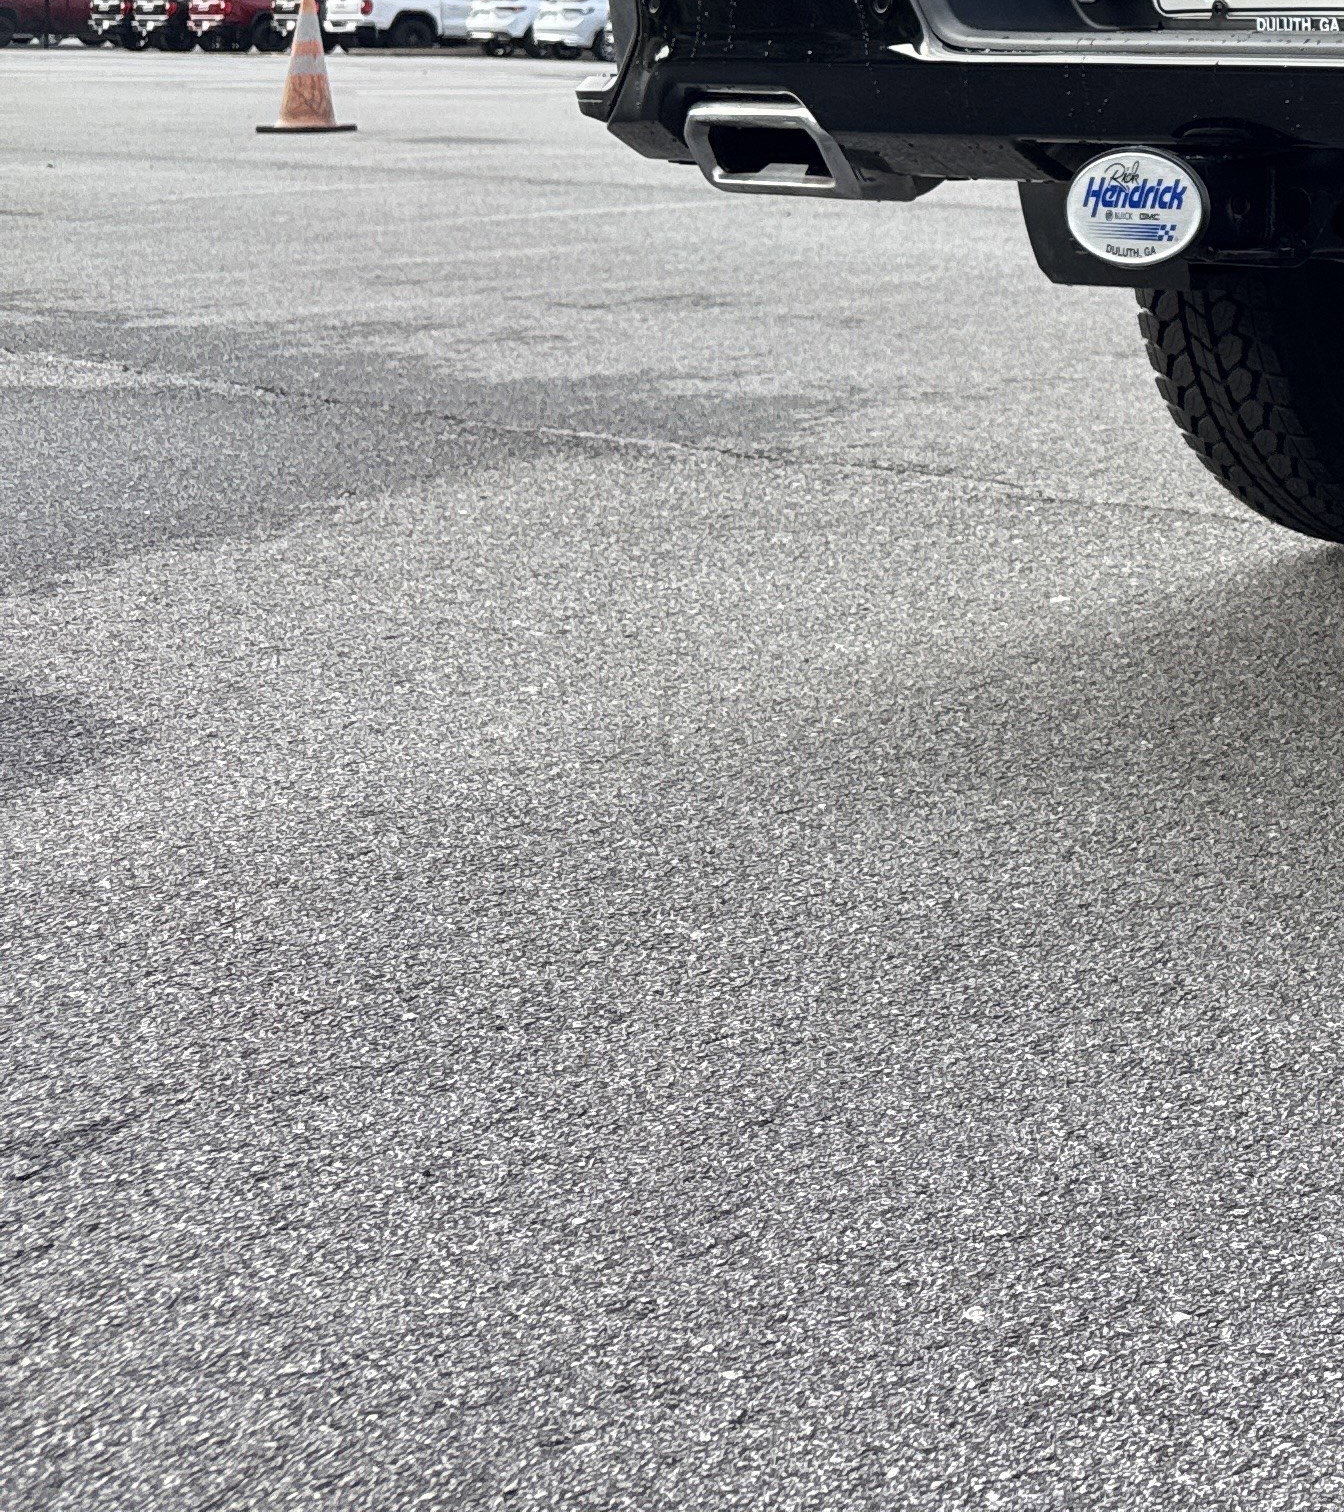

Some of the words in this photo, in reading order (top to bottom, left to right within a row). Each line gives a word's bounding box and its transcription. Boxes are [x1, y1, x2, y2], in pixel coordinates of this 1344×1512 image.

[1319, 16, 1340, 32] GA
[1083, 176, 1187, 218] Hendrick
[1144, 245, 1157, 256] GA
